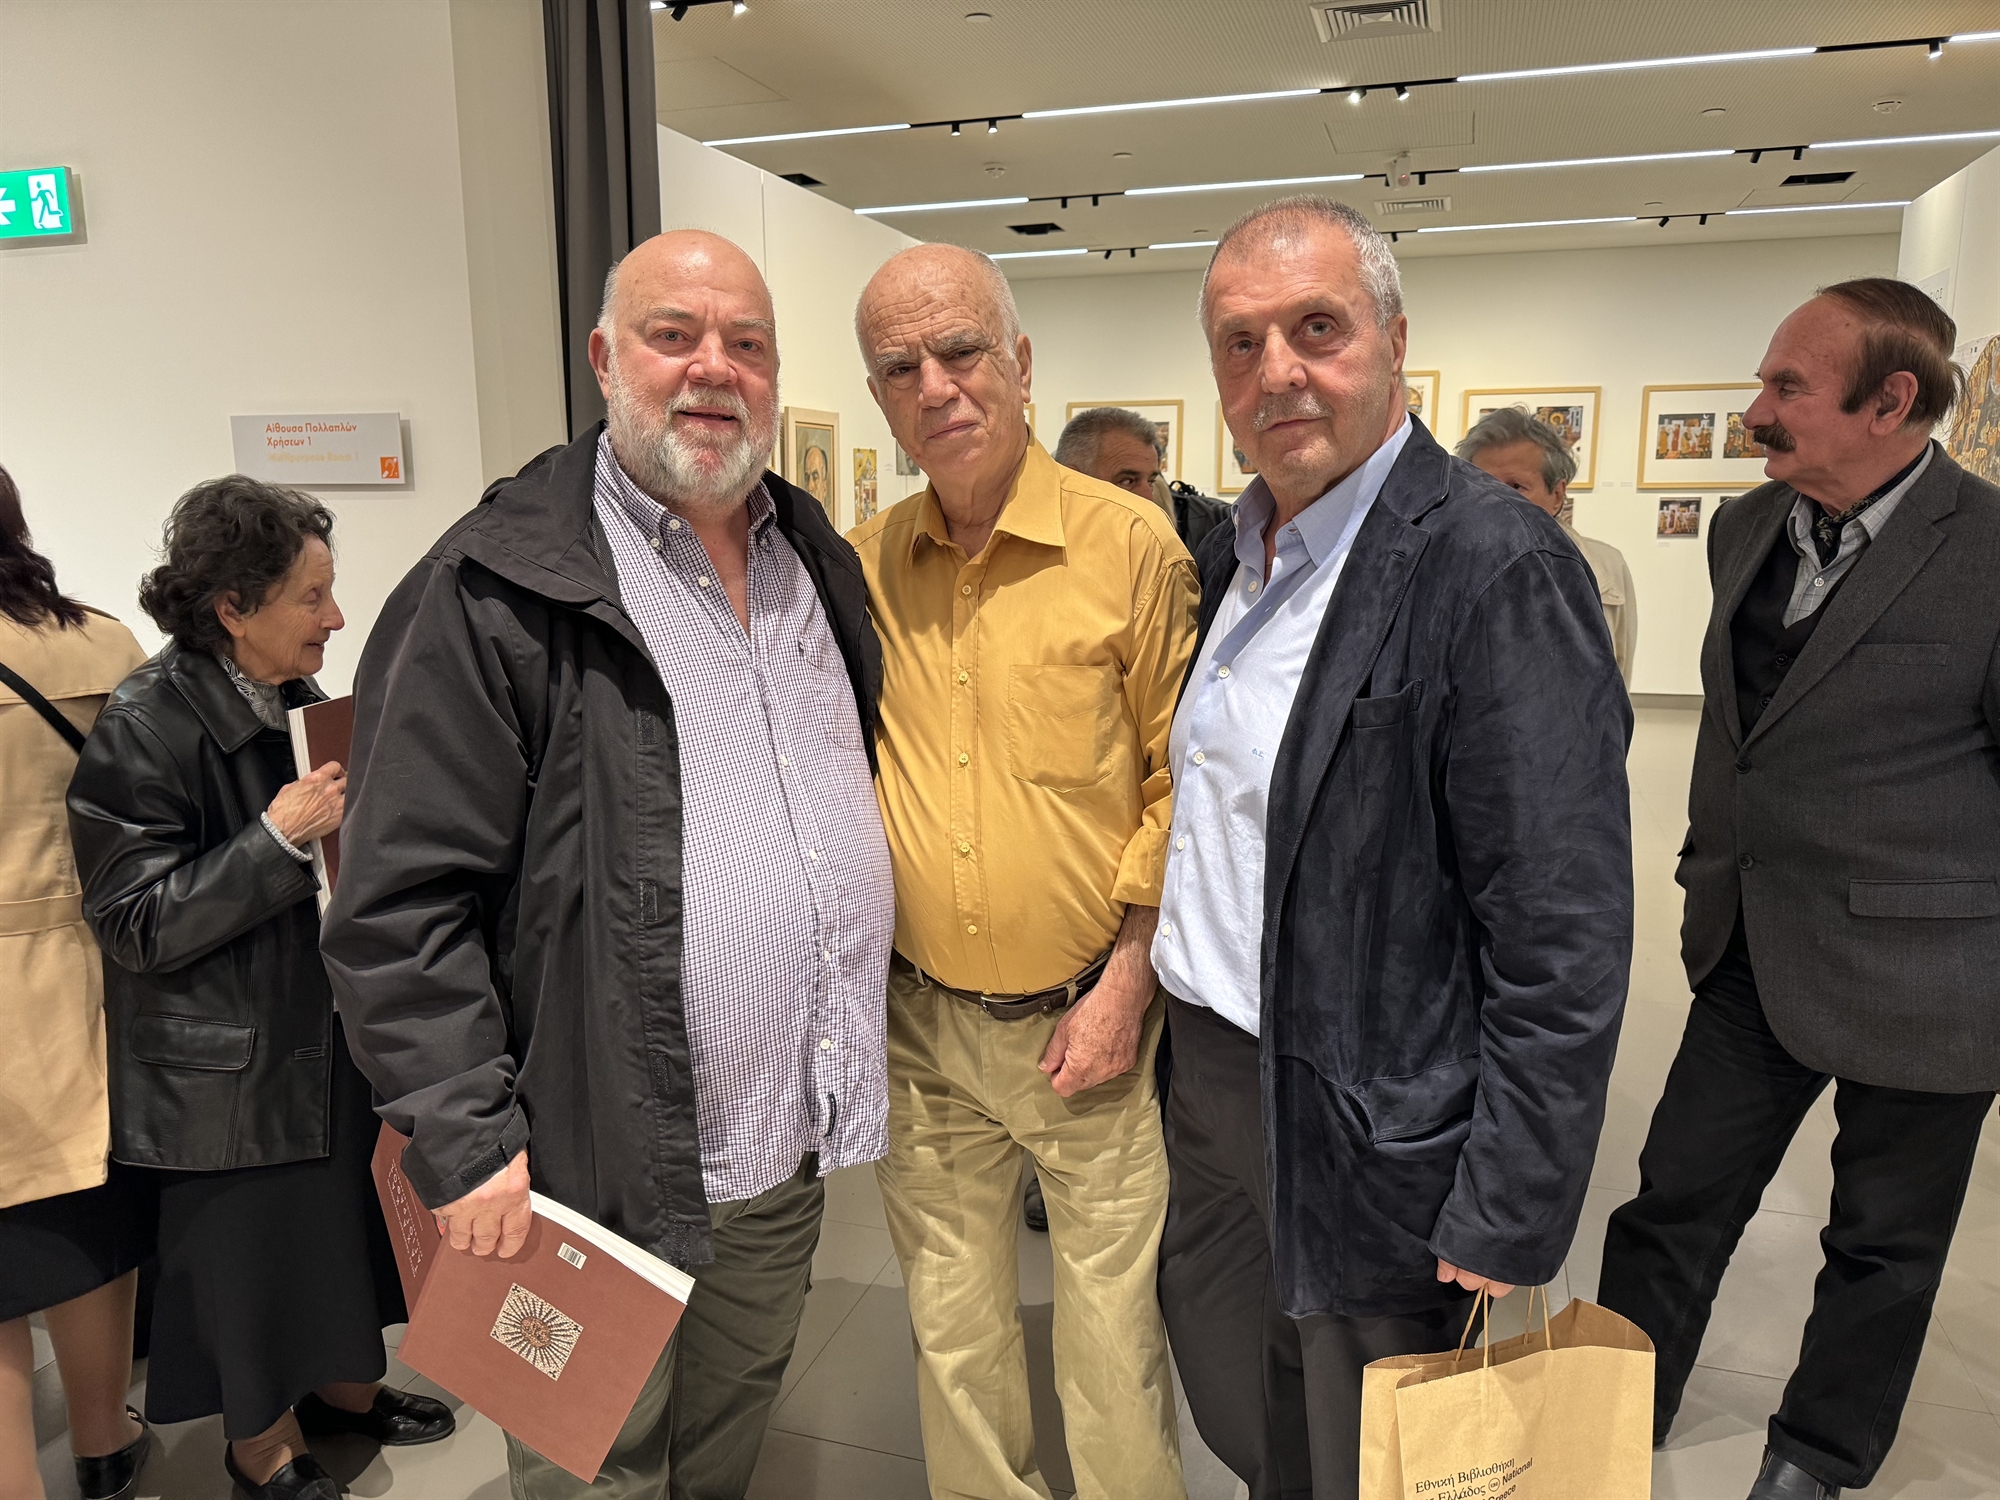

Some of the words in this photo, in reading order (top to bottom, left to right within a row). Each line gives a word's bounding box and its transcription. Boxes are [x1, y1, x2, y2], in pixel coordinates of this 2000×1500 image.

[265, 422, 303, 433] Αίθουσα
[305, 421, 357, 432] Πολλαπλών
[266, 436, 305, 448] Χρήσεων
[307, 436, 312, 446] 1
[1415, 1474, 1455, 1494] Εθνική
[1457, 1458, 1515, 1483] Βιβλιοθήκη
[1502, 1457, 1533, 1486] National
